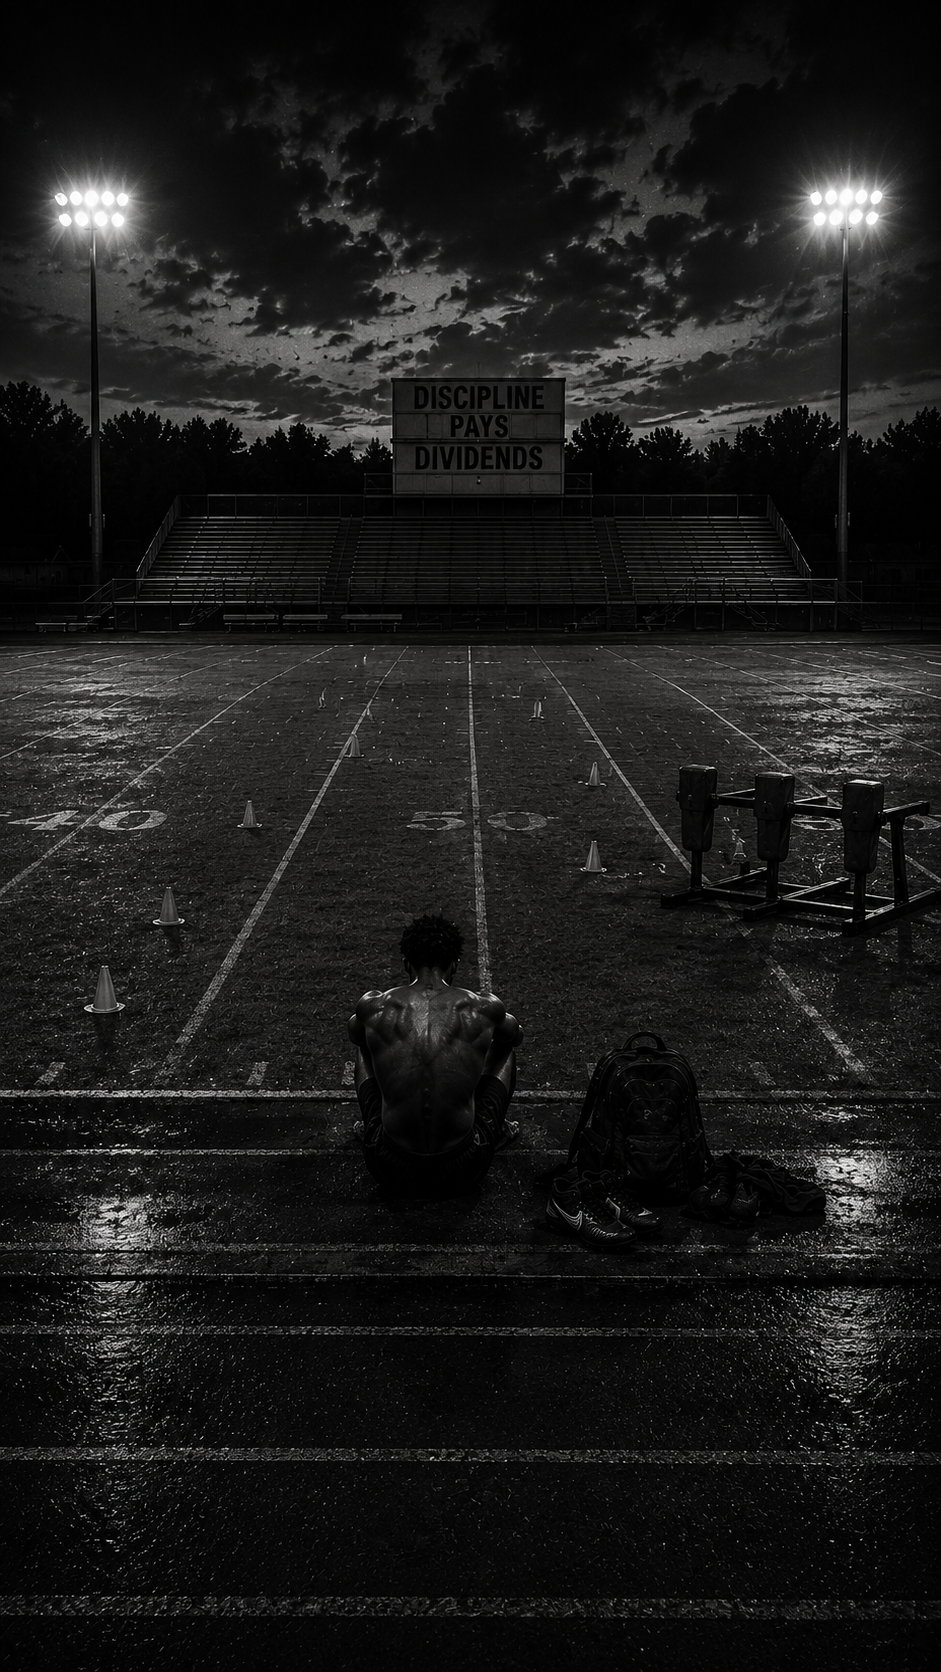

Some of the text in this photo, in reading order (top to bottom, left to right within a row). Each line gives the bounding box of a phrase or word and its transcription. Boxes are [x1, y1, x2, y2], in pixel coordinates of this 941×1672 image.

[414, 385, 545, 409] DISCIPLINE
[450, 415, 509, 437] PAYS
[415, 446, 543, 470] DIVIDENDS
[7, 809, 168, 831] 40
[406, 811, 548, 831] 50
